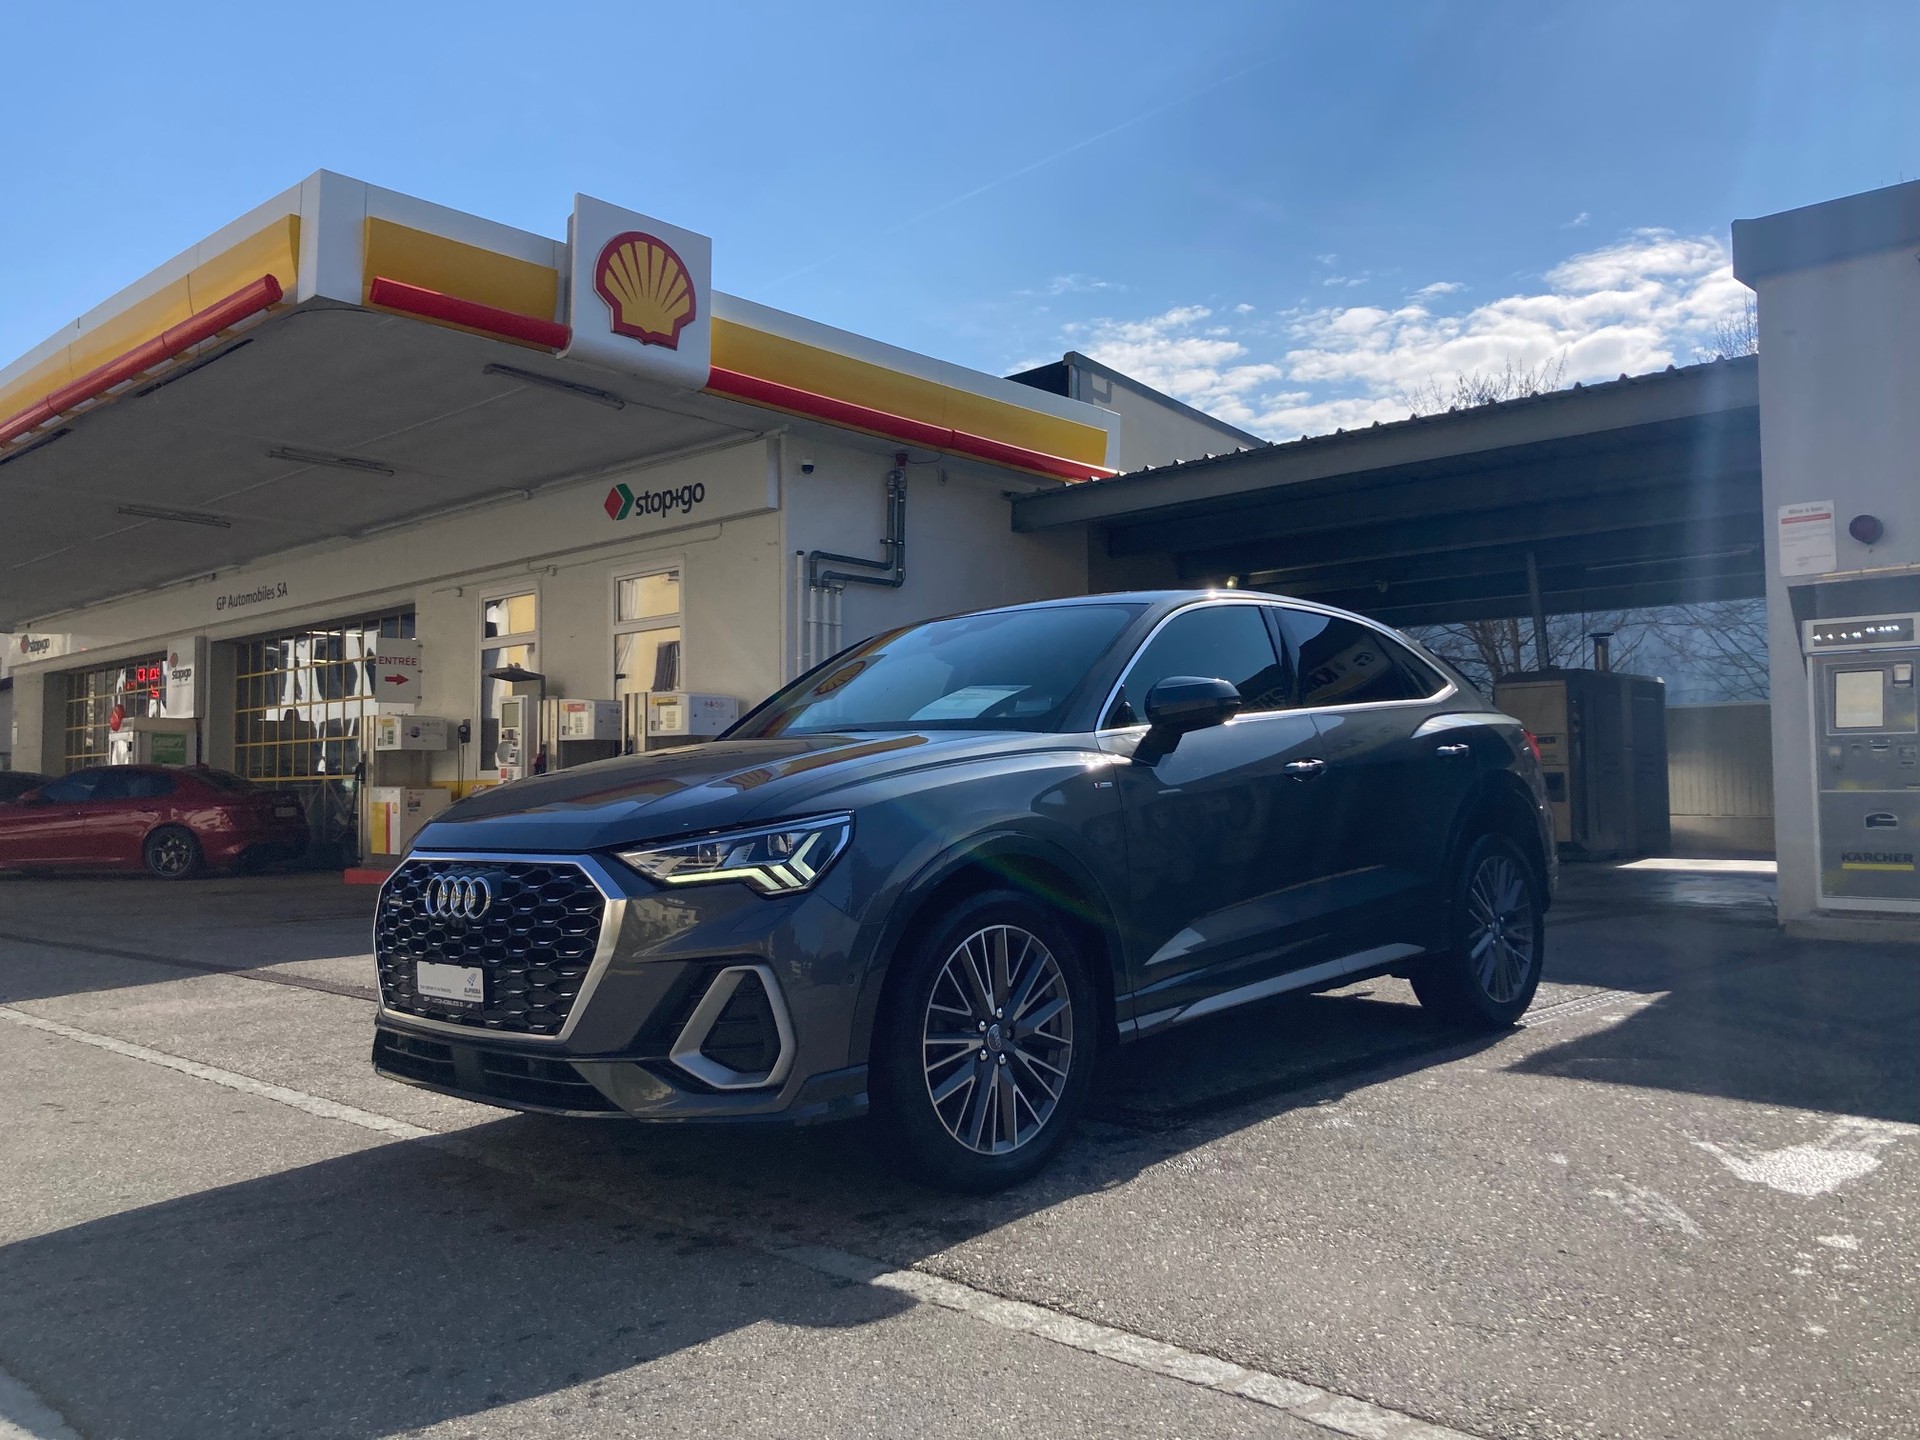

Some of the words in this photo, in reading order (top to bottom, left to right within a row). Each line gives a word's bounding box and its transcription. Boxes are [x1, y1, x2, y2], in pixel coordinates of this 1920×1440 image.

[635, 482, 705, 518] stop+go
[216, 596, 227, 610] GP
[228, 585, 275, 608] Automobiles
[276, 581, 288, 598] SA
[378, 656, 417, 666] ENTRÉE
